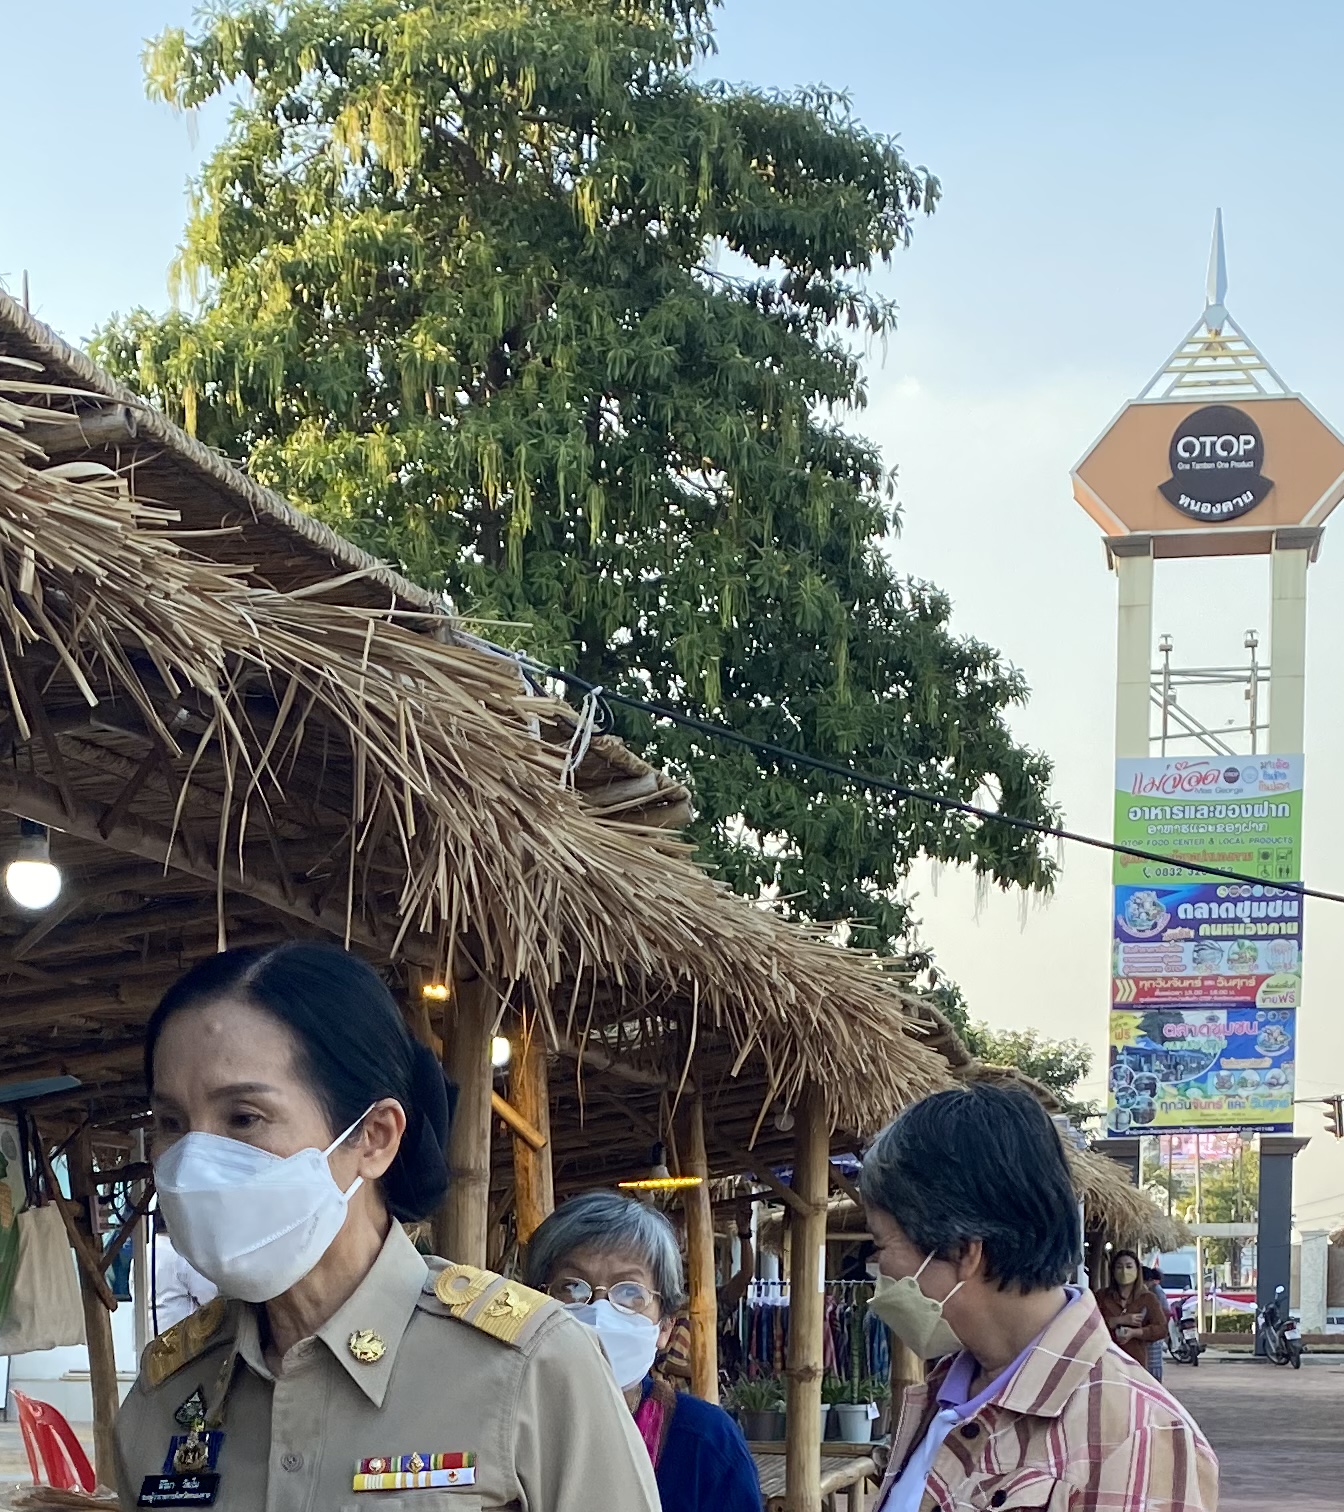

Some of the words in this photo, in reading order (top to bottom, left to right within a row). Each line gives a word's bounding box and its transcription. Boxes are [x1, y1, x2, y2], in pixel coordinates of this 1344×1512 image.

[1176, 434, 1256, 458] OTOP
[1178, 490, 1254, 514] หนองคาย
[1128, 801, 1290, 821] อาหารและของฝาก
[1147, 839, 1169, 847] FOOD
[1219, 837, 1245, 845] LOCAL
[1249, 836, 1293, 844] PRODUCTS
[1177, 900, 1299, 923] ตลาดชุมชน
[1199, 922, 1298, 936] คนหนองคาย
[1163, 1021, 1259, 1041] ตลาดชุมชน
